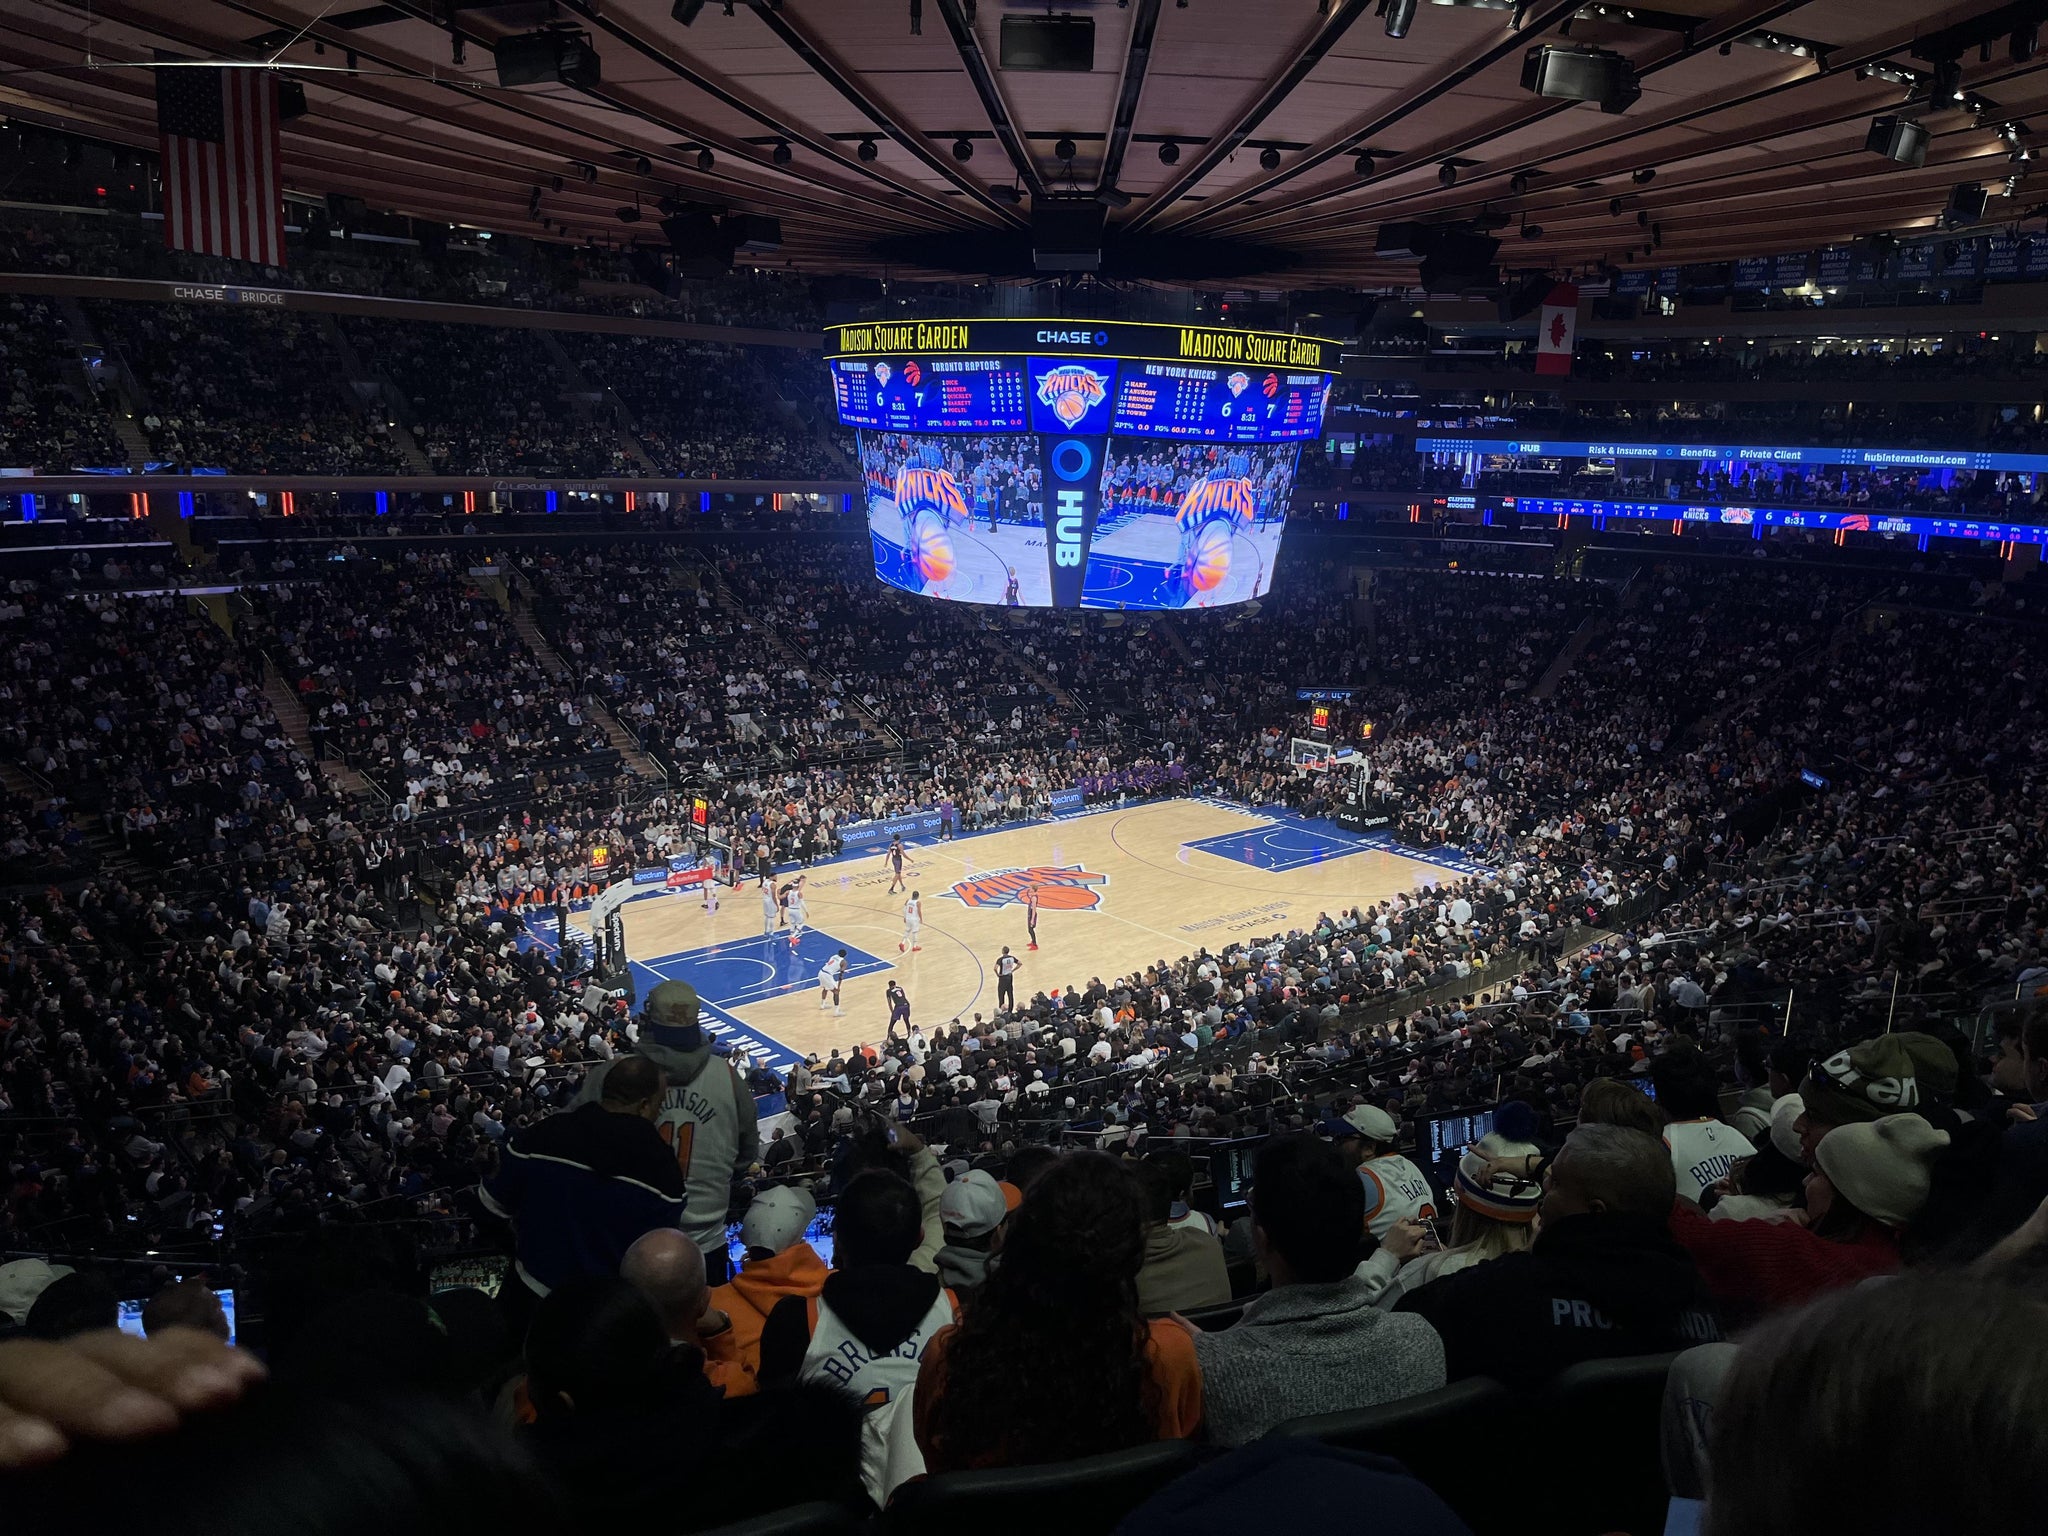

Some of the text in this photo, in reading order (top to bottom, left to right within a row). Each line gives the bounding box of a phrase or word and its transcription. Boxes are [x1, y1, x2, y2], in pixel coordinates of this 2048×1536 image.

[174, 287, 284, 305] CHASE BRIDGE
[840, 323, 968, 352] MADISON SQUARE GARDEN
[1036, 330, 1091, 344] CHASE
[1179, 329, 1321, 366] MADISON SQUARE GARDEN
[931, 360, 1001, 372] TORONTO RAPTORS
[1145, 364, 1217, 380] NEW YORK KNICKS
[1041, 373, 1101, 397] KNICKS
[876, 392, 924, 408] 6 7
[891, 403, 906, 411] 8:31
[1221, 402, 1232, 417] 6
[1266, 404, 1276, 419] 7
[1240, 413, 1256, 422] 8:31
[1114, 421, 1134, 430] 3PT%
[1154, 425, 1169, 433] FG%
[1171, 426, 1186, 434] 60.0
[1204, 428, 1215, 436] 0.0
[1519, 444, 1967, 465] HUB Risk & Insurance Benefits Private Client hubinternational.com
[894, 468, 969, 518] KNICKS
[1174, 477, 1254, 524] KNICKS
[1682, 510, 1710, 520] KNICKS
[1765, 511, 1827, 524] 6 7
[1784, 516, 1805, 526] 8:31
[1056, 490, 1083, 569] HUB
[1877, 521, 1911, 532] RAPTORS
[1440, 542, 1507, 554] NEW YORK
[1313, 714, 1326, 726] 20
[692, 806, 706, 825] 20
[1364, 816, 1389, 827] Spectrum
[842, 822, 916, 842] Spectrum Spectrum
[1356, 838, 1440, 862] NEW YORK
[634, 870, 666, 882] Spectrum
[954, 866, 1107, 907] KNICKS
[612, 912, 622, 952] Spectrum
[1227, 916, 1273, 932] CHASE
